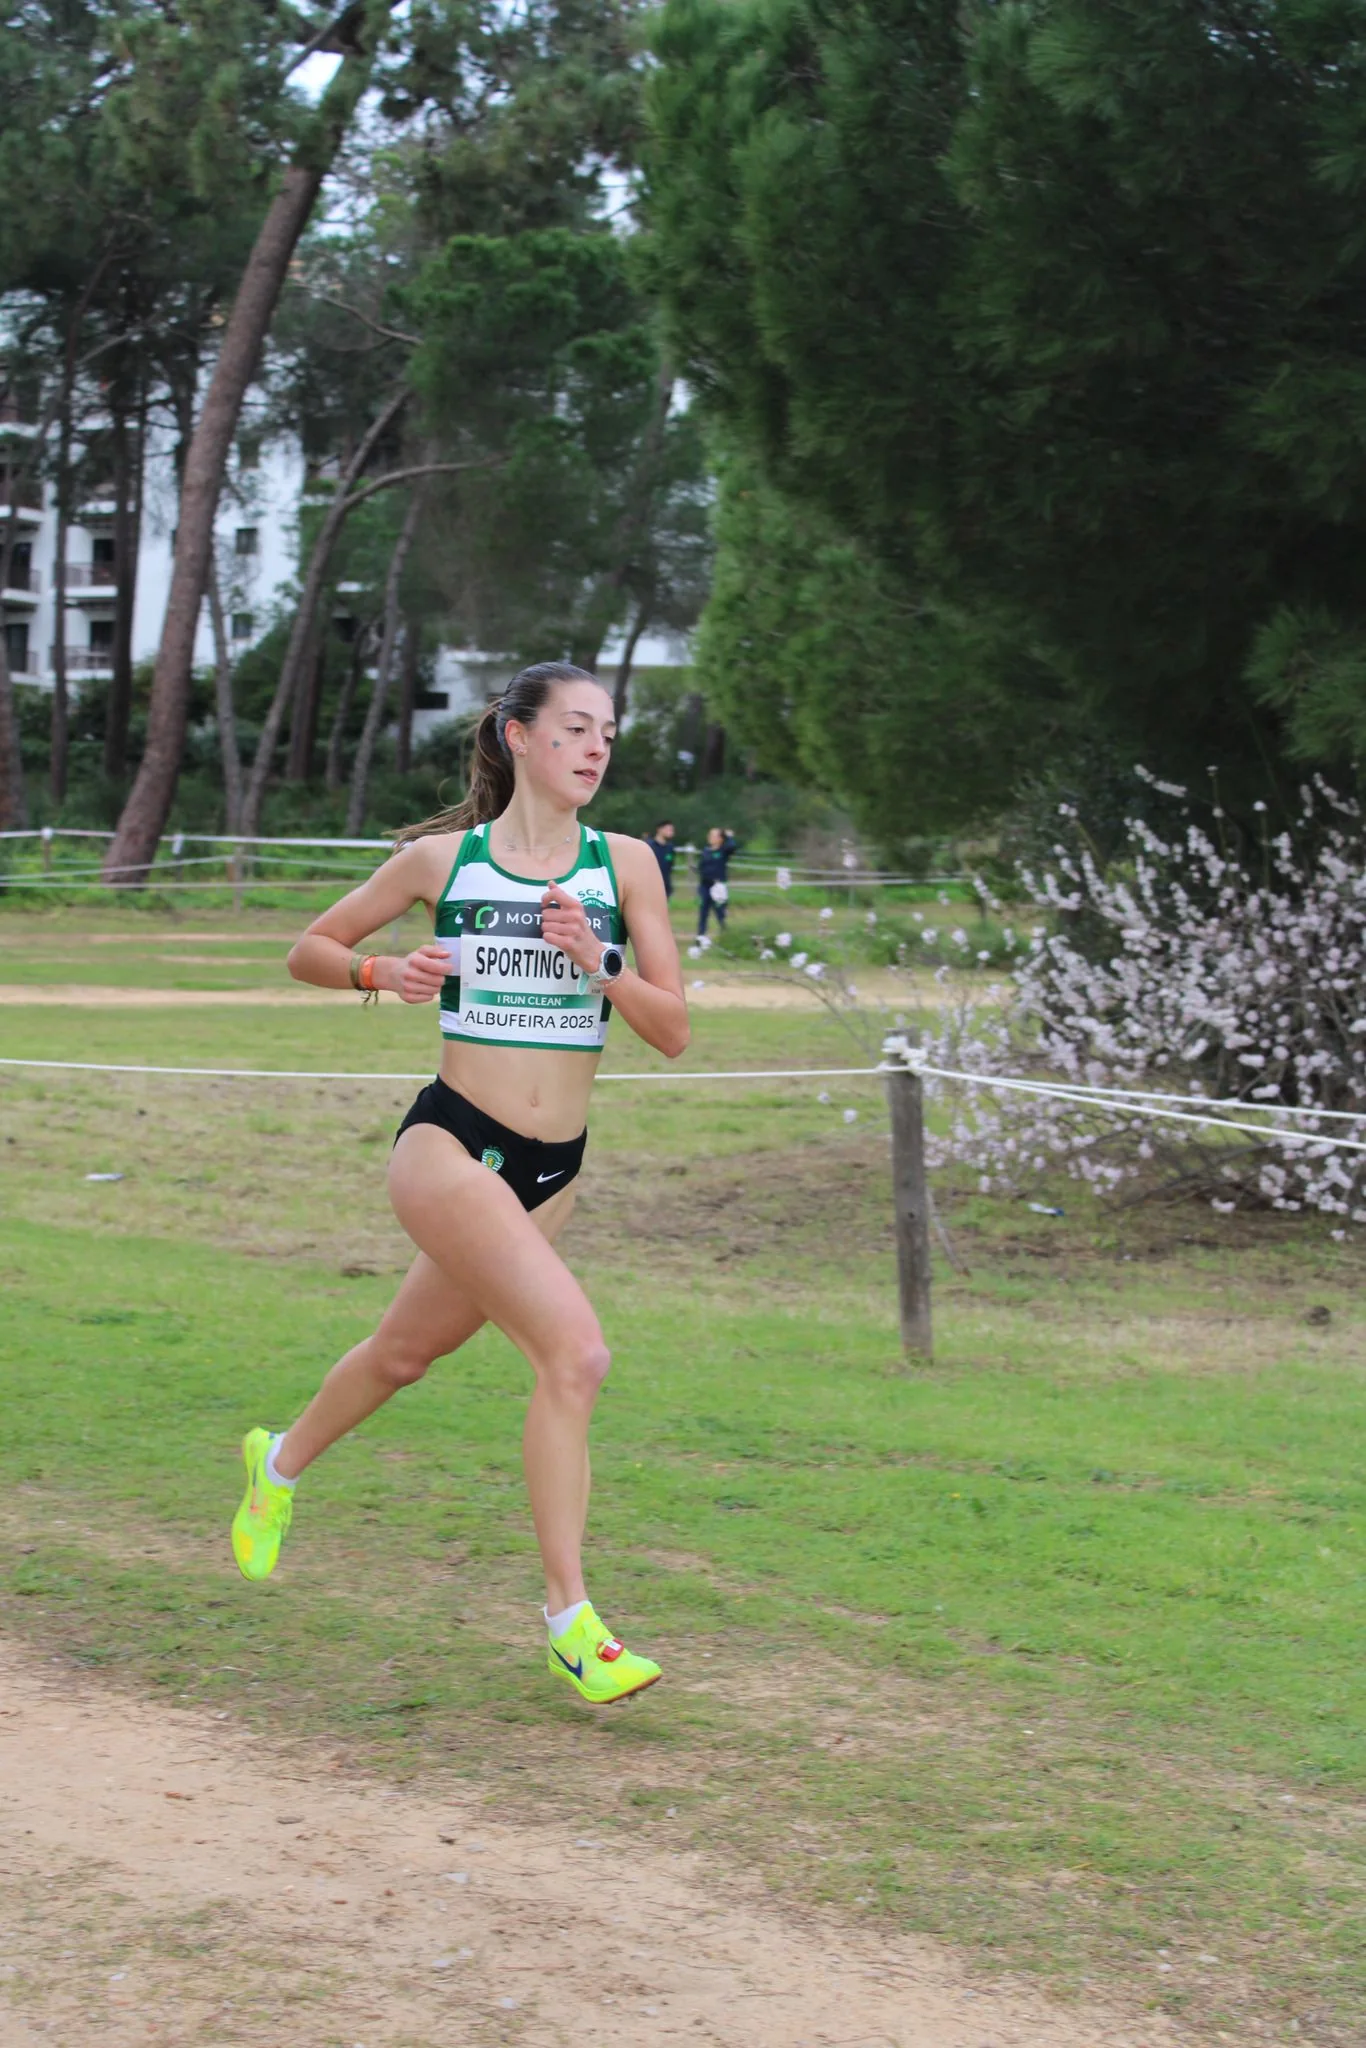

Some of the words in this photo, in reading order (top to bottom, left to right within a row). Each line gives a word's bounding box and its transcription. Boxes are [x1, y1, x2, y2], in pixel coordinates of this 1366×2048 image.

[577, 888, 604, 899] SCP
[475, 946, 565, 980] SPORTING
[502, 996, 526, 1004] RUN
[464, 1010, 556, 1028] ALBUFEIRA
[560, 1015, 594, 1029] 2025
